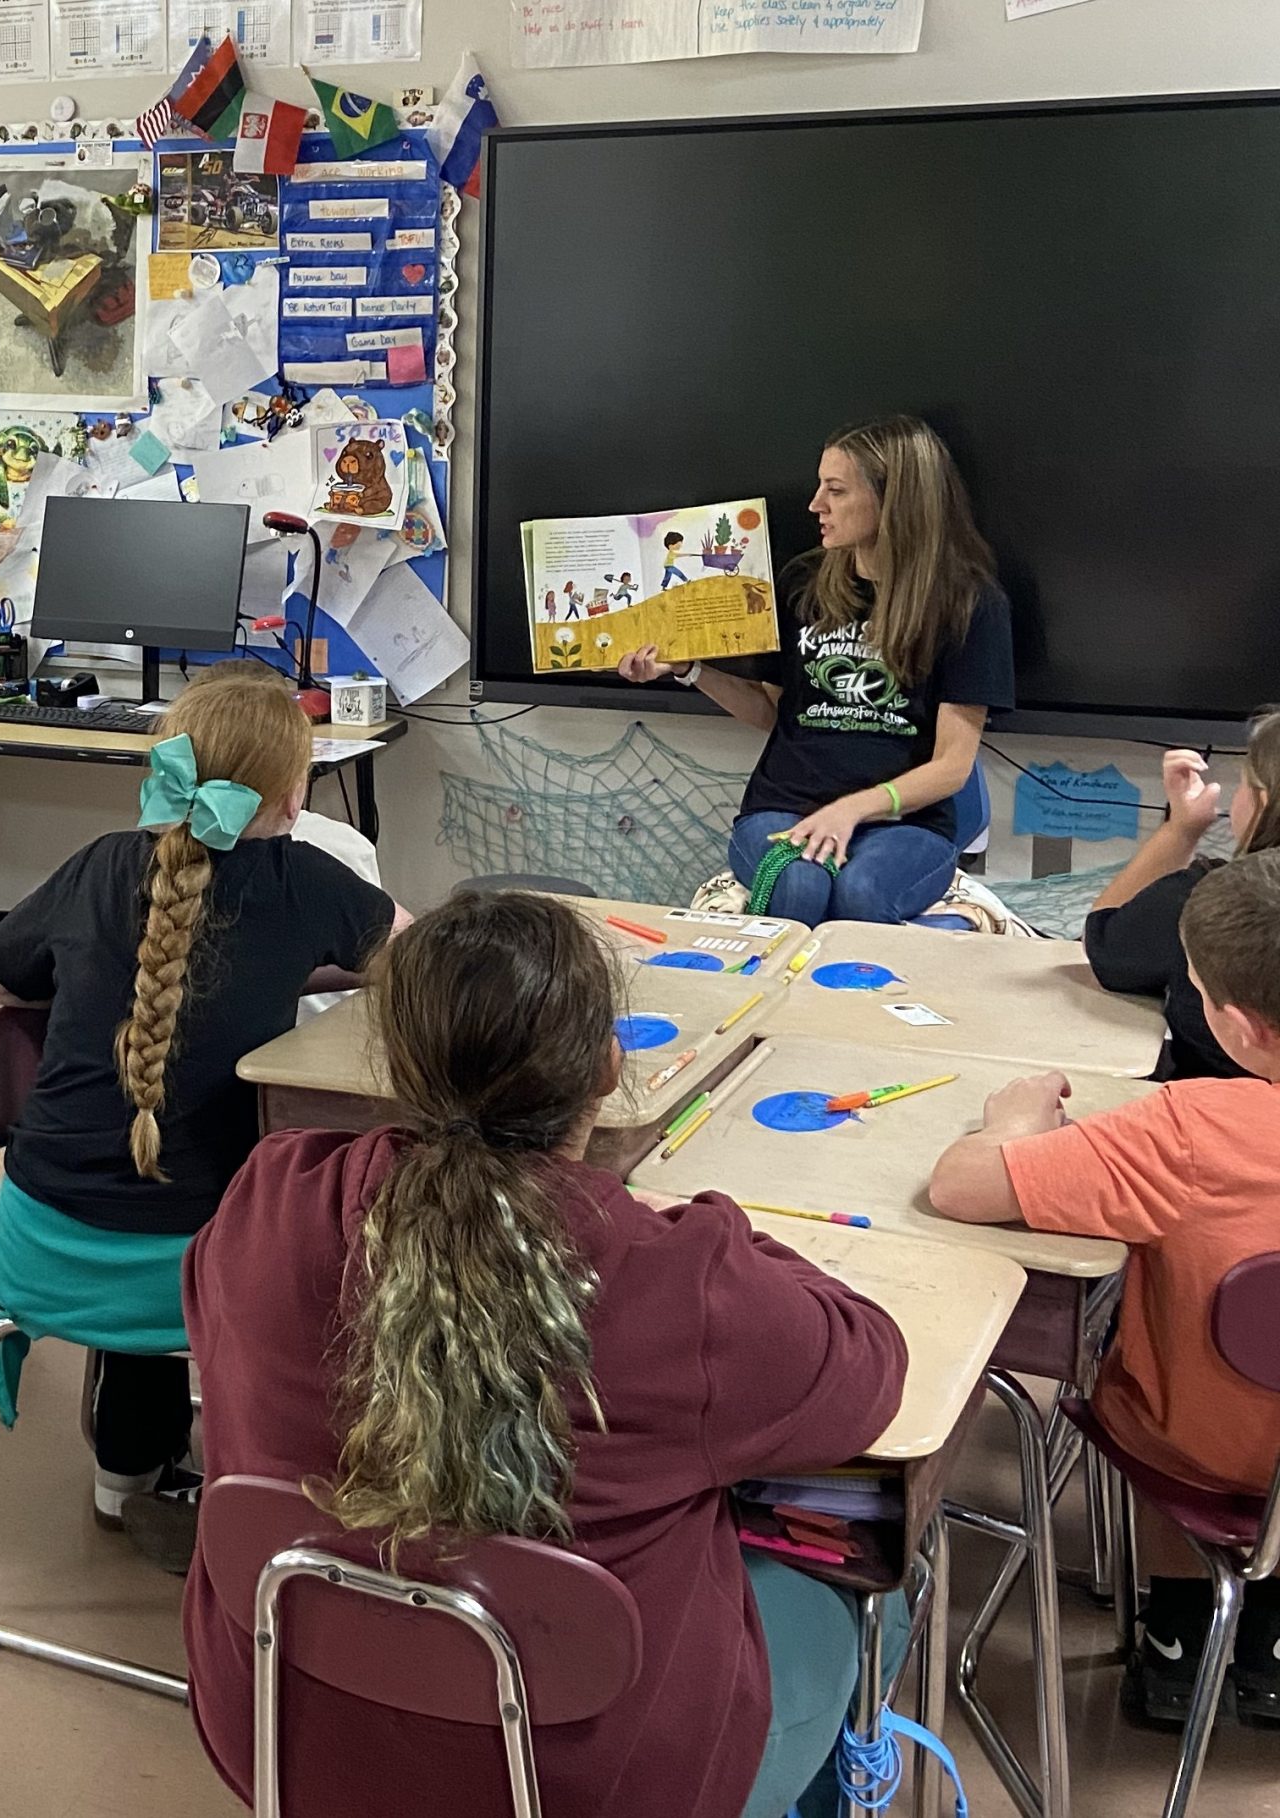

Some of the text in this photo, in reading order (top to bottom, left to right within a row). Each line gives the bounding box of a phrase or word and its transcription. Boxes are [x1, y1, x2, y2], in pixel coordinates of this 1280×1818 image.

[290, 236, 315, 249] Extra
[330, 271, 348, 285] Day
[391, 300, 416, 312] Party
[352, 334, 397, 348] Game Day
[369, 424, 401, 442] cute
[797, 714, 881, 732] Brave Strong
